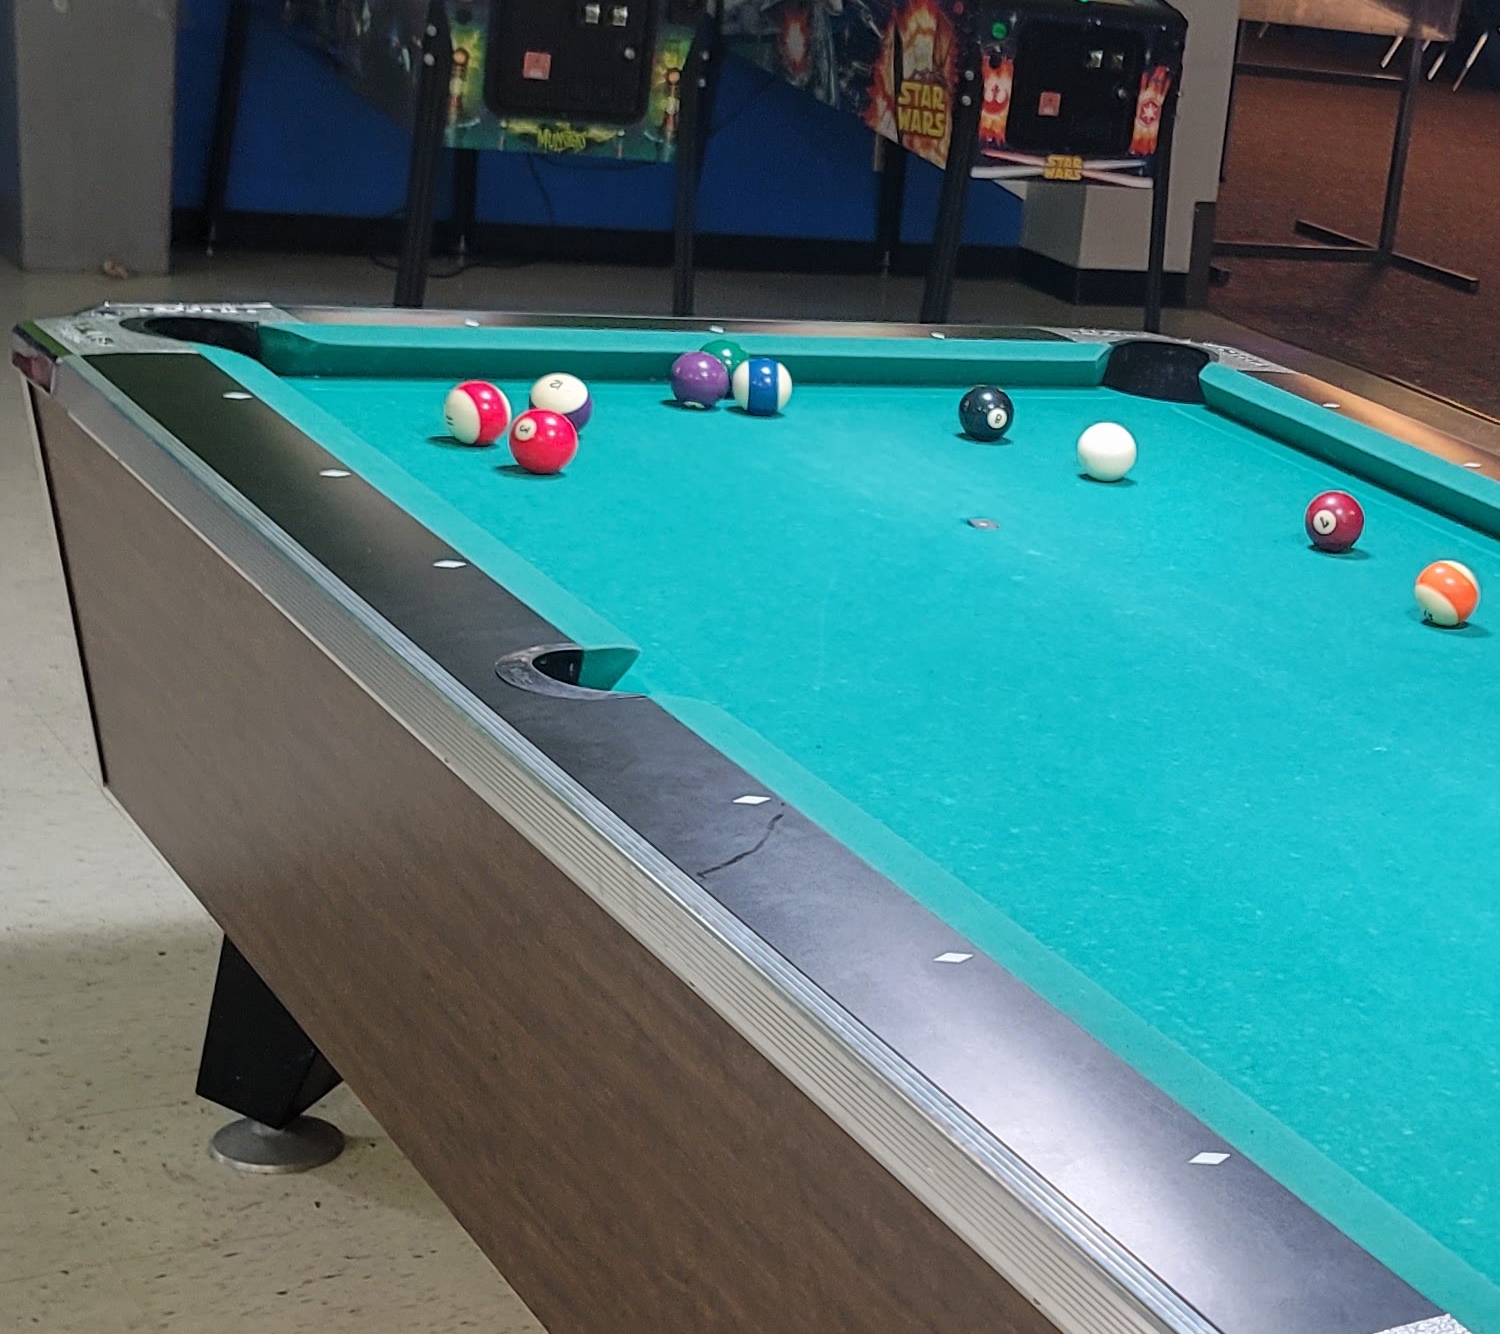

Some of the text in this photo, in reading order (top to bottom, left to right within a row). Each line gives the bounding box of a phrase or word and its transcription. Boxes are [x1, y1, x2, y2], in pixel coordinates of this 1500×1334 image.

[898, 81, 945, 110] STAR
[898, 107, 945, 137] WARS
[1046, 154, 1082, 169] STAR
[1045, 167, 1081, 180] WARS
[994, 413, 1002, 424] 8
[519, 424, 531, 434] 3
